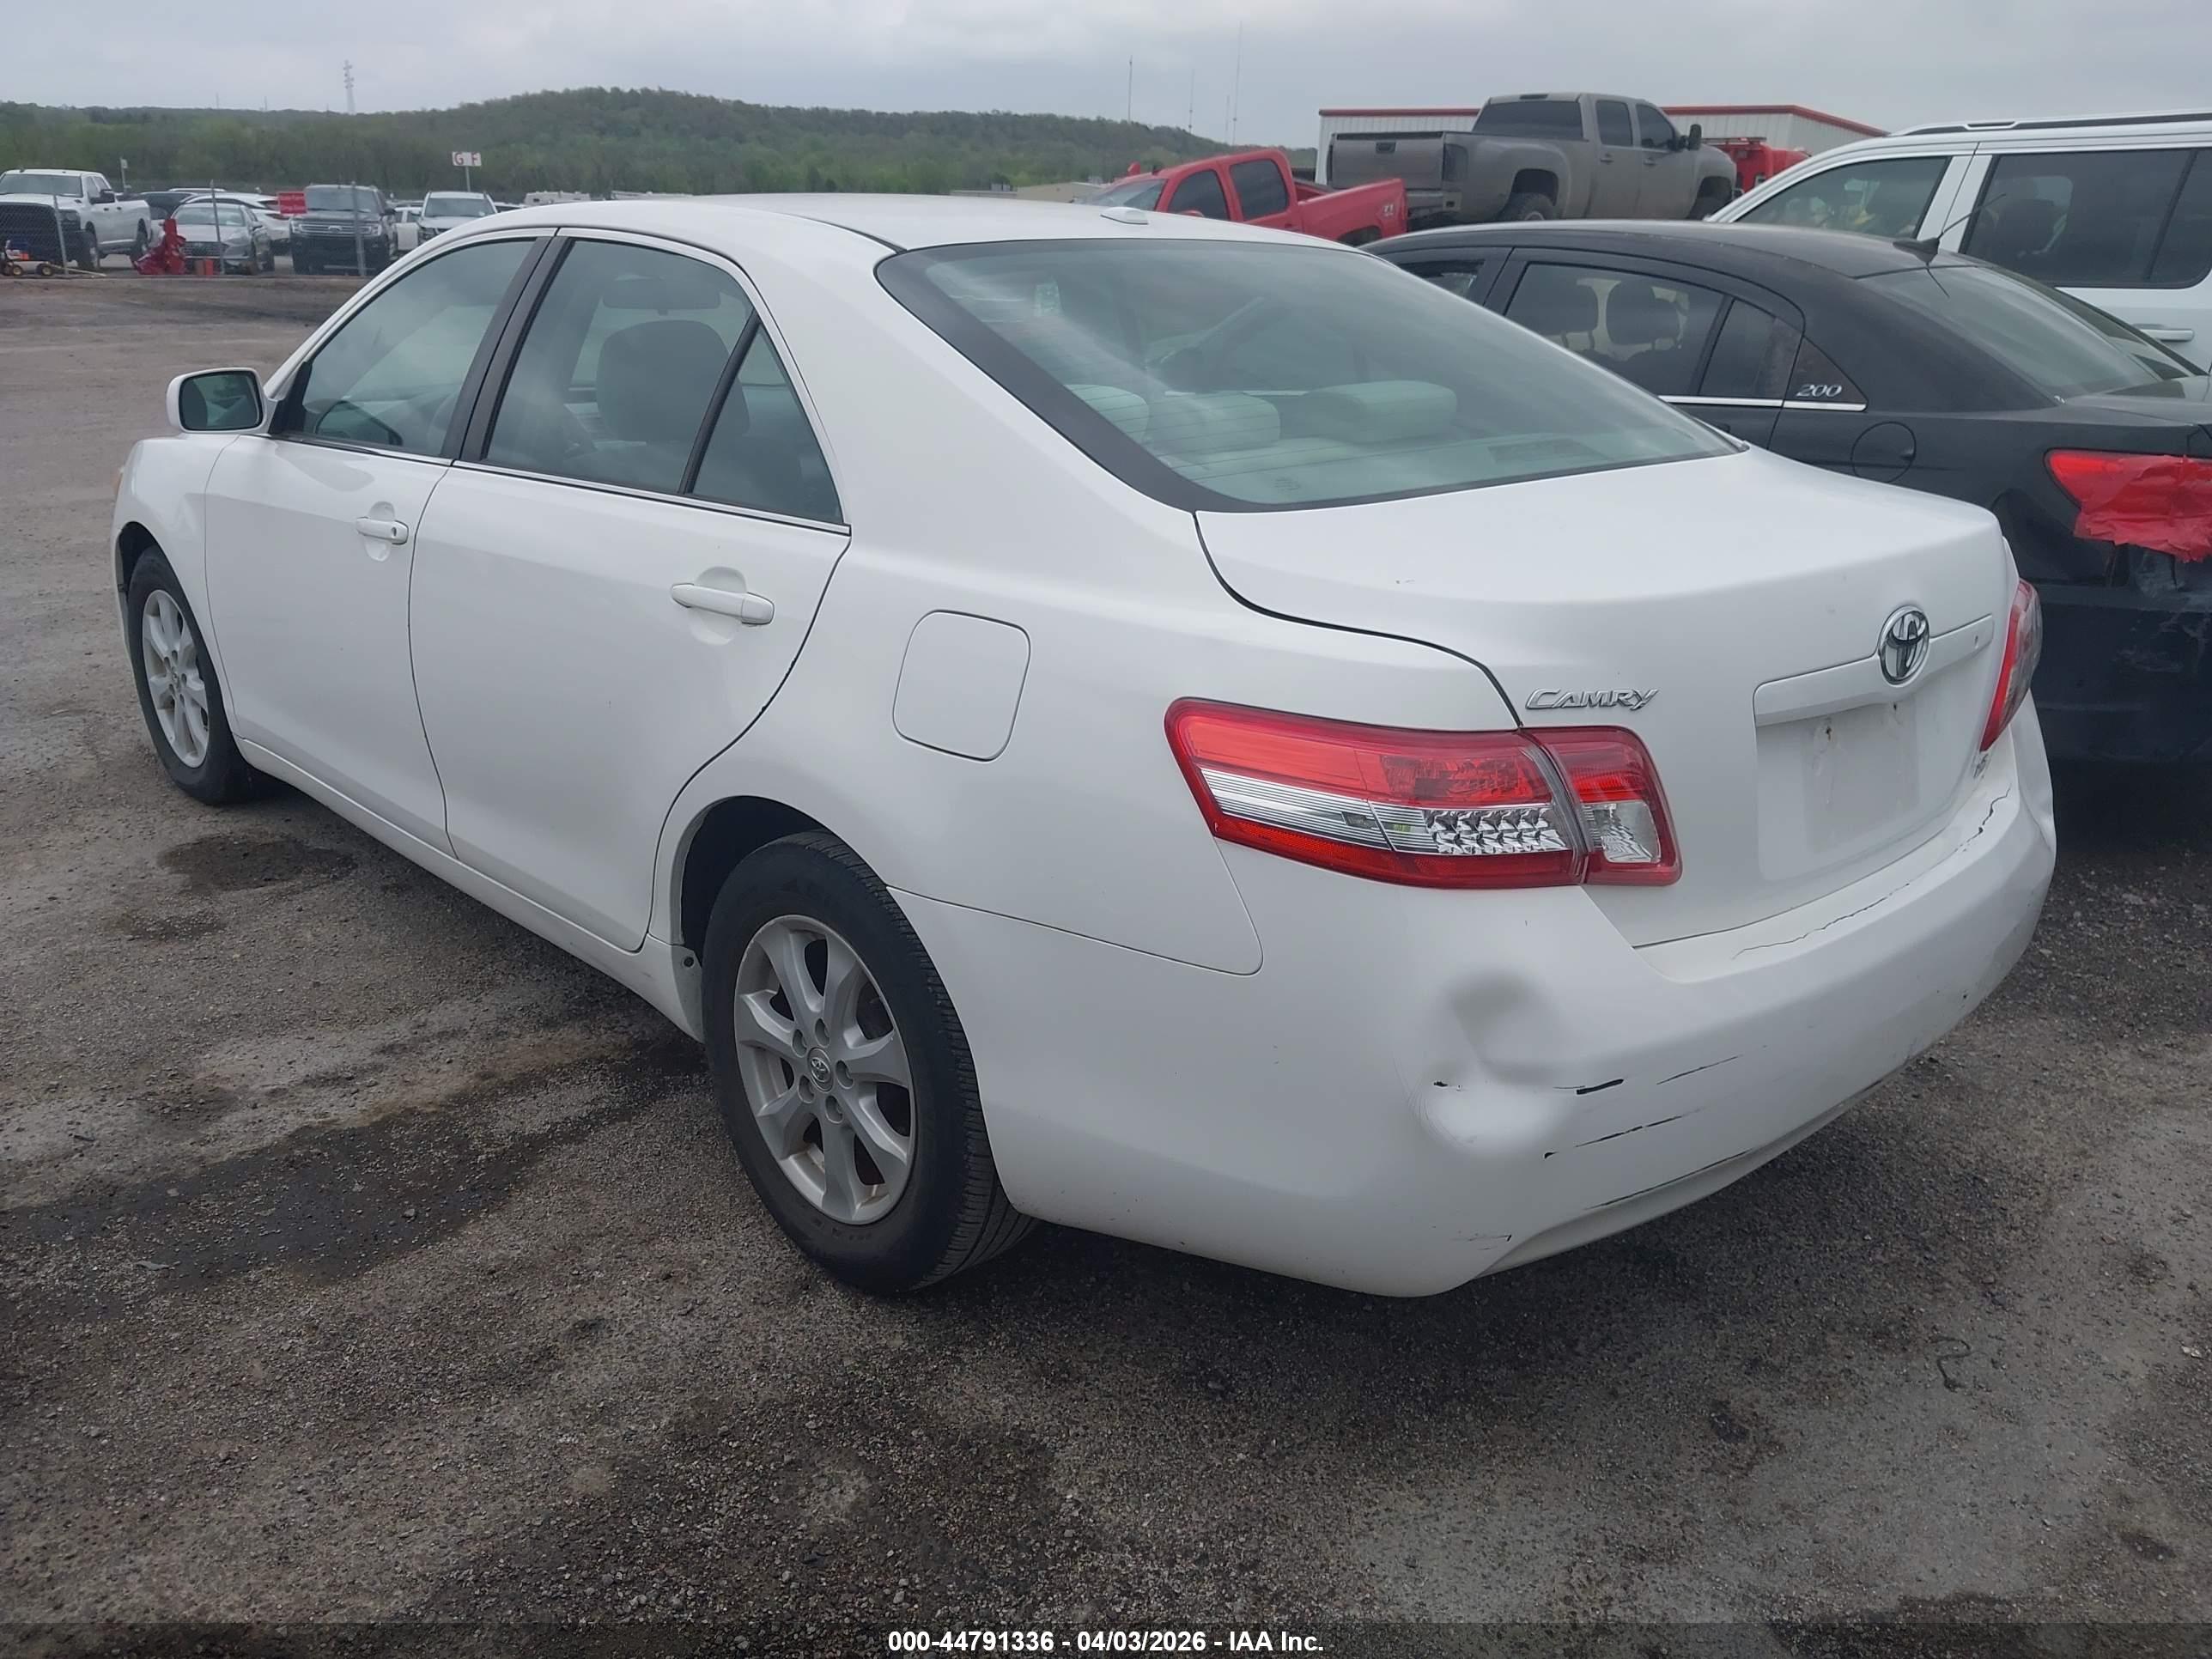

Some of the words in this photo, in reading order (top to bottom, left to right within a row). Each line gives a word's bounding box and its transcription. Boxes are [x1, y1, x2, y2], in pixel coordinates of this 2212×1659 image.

[454, 151, 465, 166] G
[1796, 383, 1843, 398] 200
[1525, 687, 1659, 711] CAMRY
